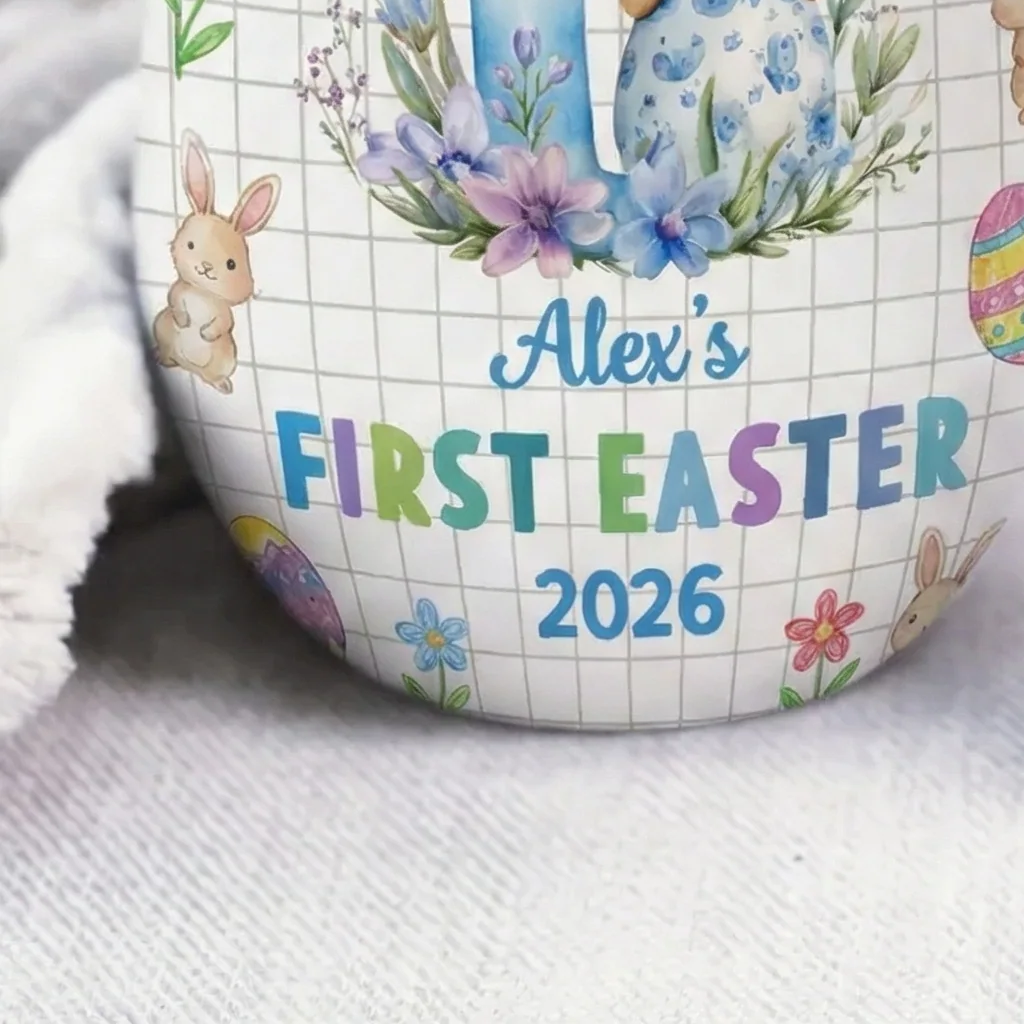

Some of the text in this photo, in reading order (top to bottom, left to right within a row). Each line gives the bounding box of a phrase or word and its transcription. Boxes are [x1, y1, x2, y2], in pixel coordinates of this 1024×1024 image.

[490, 294, 751, 390] Alex's
[275, 396, 969, 532] FIRST EASTER
[535, 564, 725, 639] 2026
